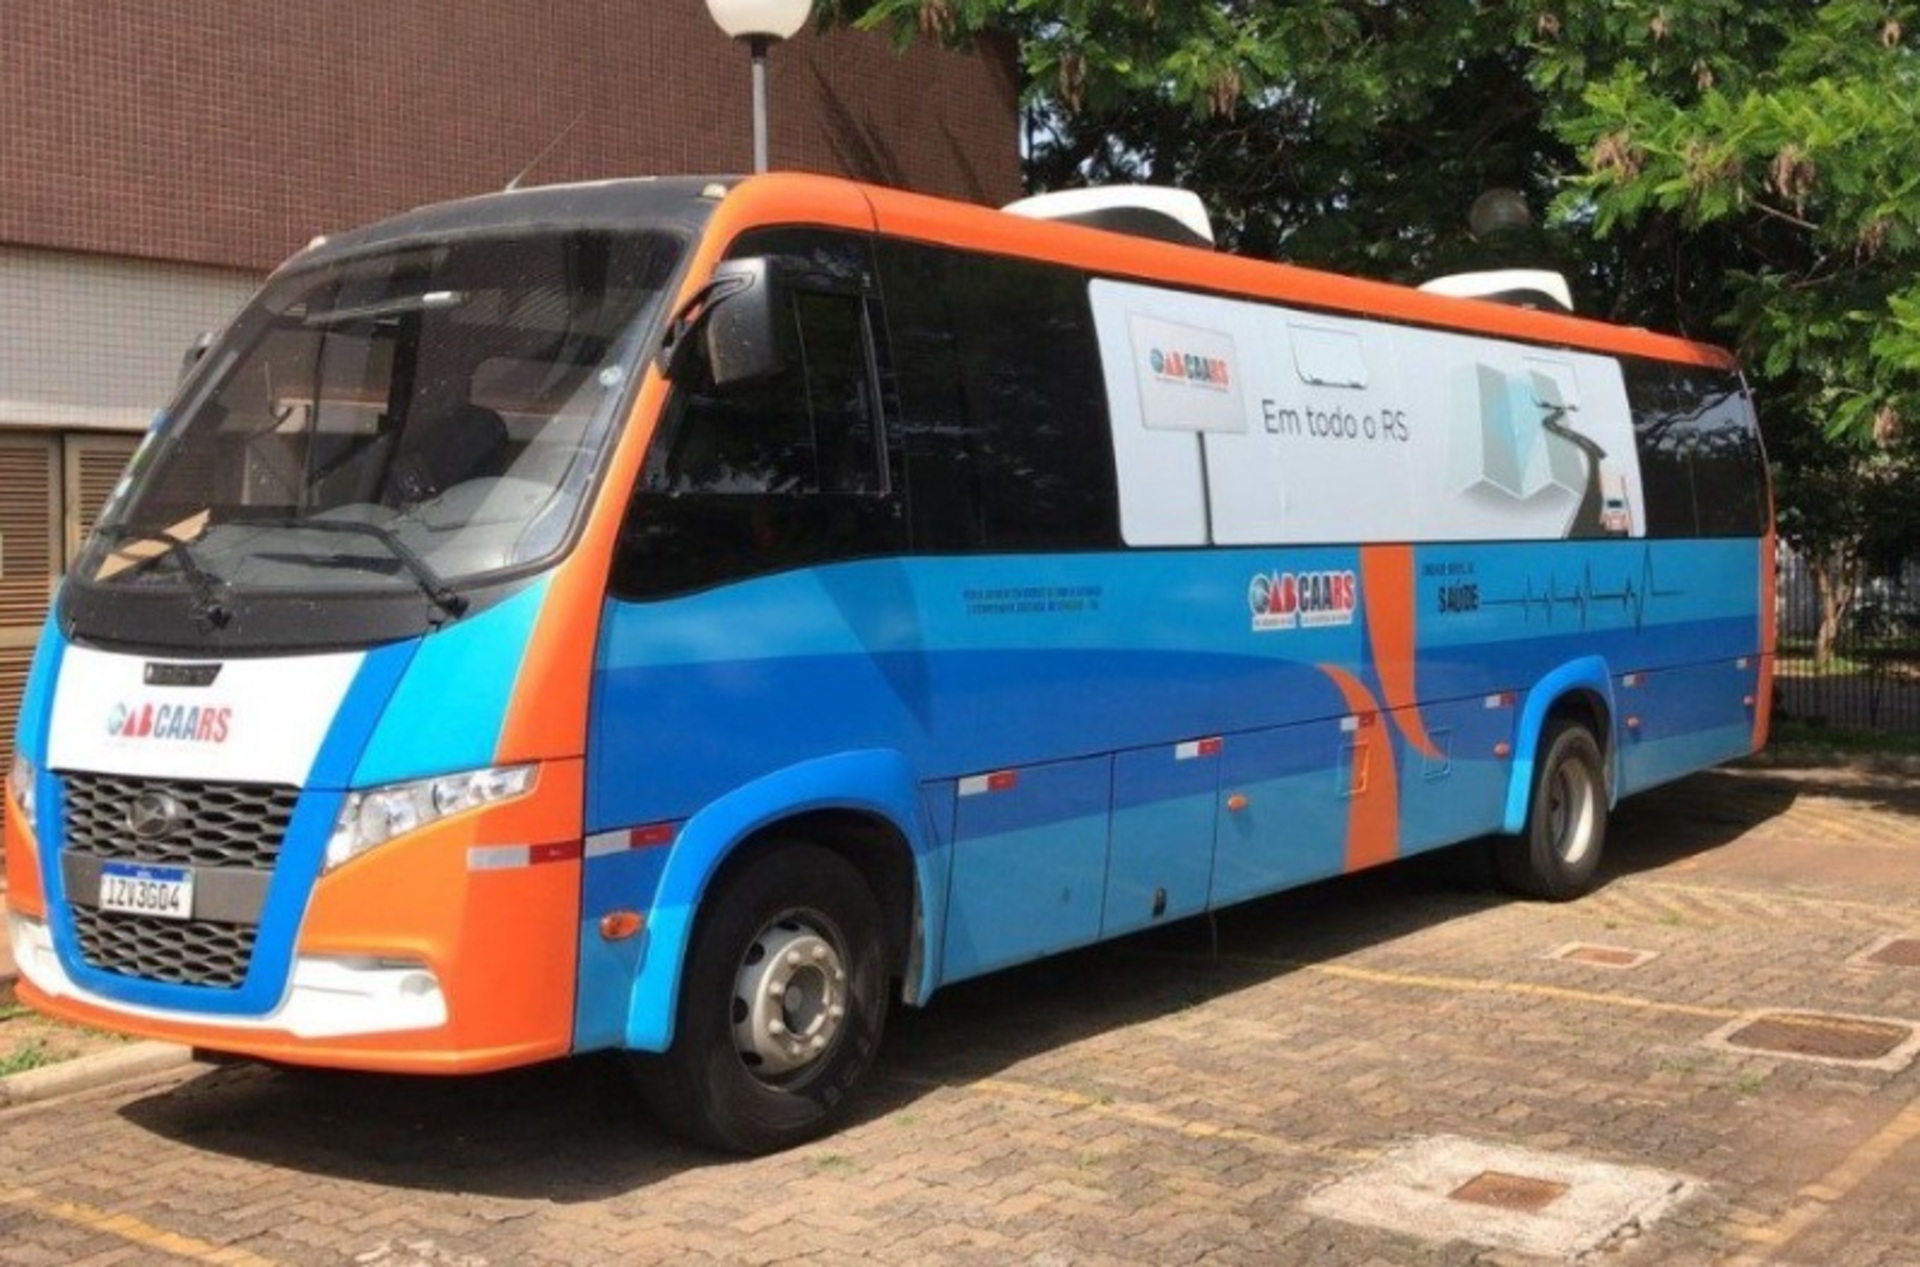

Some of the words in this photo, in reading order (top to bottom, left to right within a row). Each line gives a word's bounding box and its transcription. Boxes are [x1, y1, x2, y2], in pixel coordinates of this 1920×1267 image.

[1262, 399, 1299, 434] Em
[1306, 404, 1357, 438] todo
[1363, 417, 1376, 439] o
[1382, 409, 1409, 442] RS
[1438, 577, 1479, 614] SAÚDE
